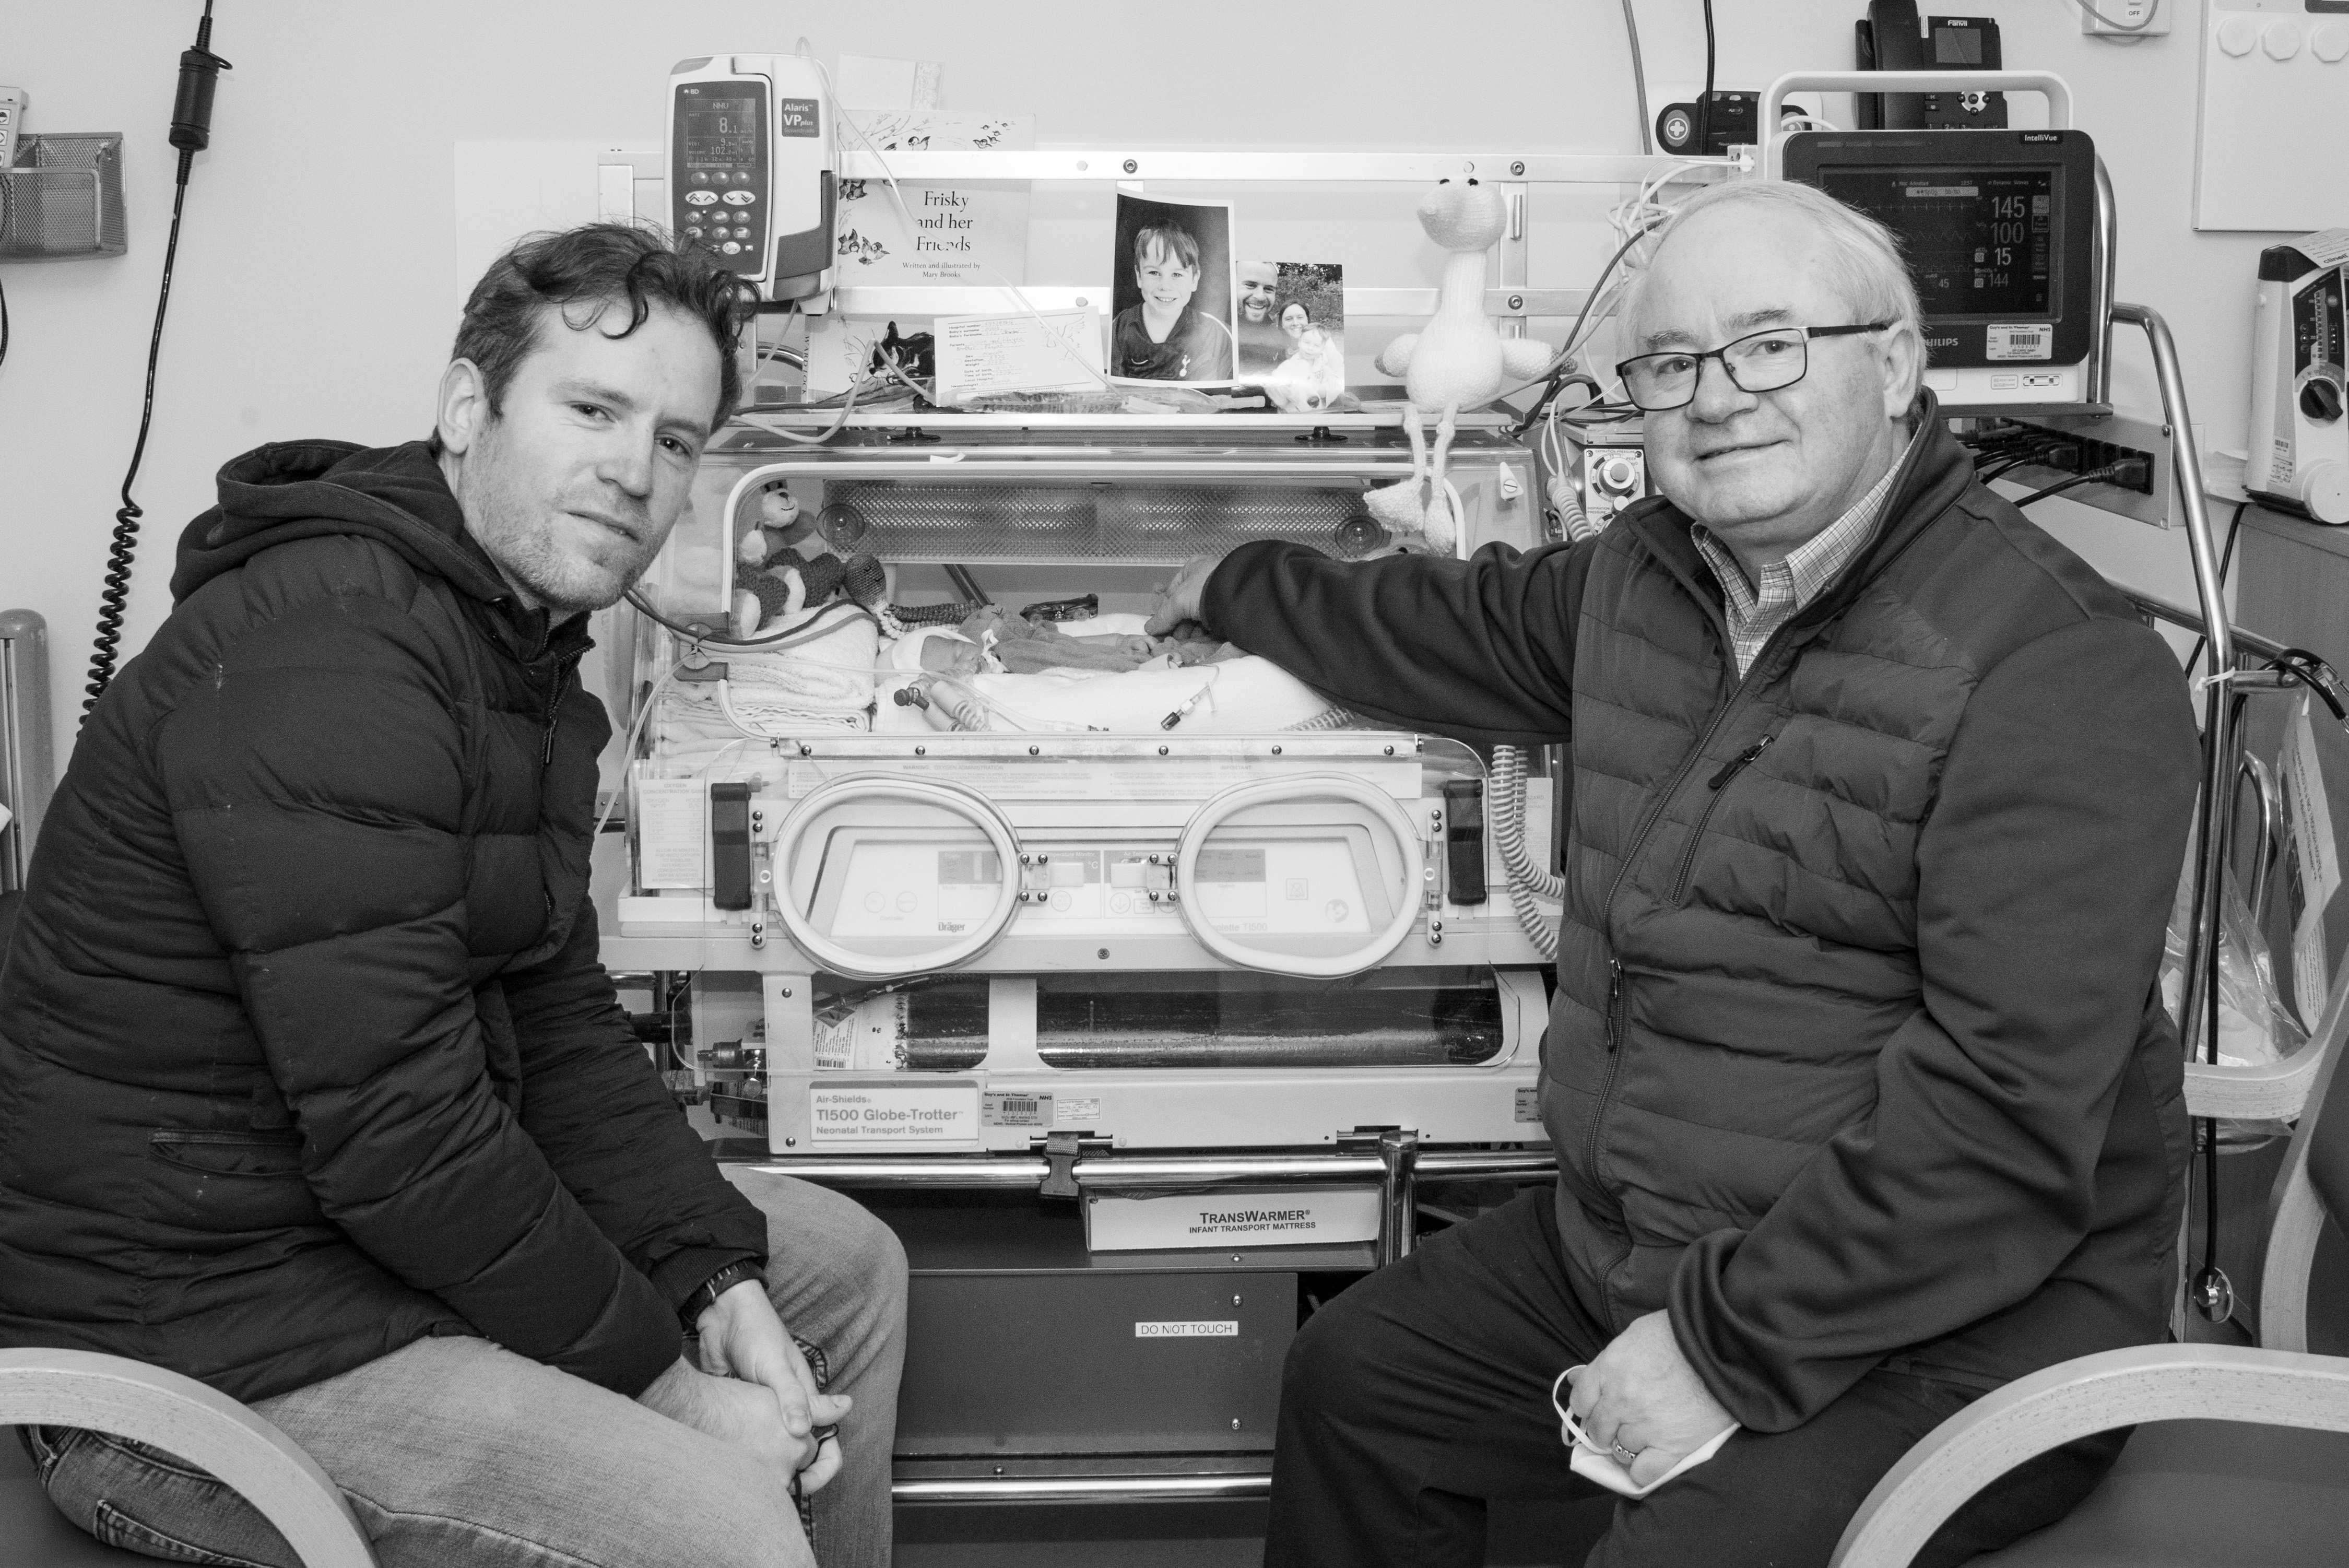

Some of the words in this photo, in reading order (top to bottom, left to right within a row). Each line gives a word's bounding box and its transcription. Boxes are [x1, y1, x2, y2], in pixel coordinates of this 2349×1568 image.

[924, 191, 969, 213] Frisky
[1991, 196, 2025, 218] 145
[917, 213, 943, 229] and
[949, 213, 973, 229] her
[1990, 222, 2024, 244] 100
[1994, 247, 2011, 265] 15
[973, 262, 981, 271] by
[923, 272, 938, 280] Mary
[1988, 273, 2009, 288] 144
[1938, 279, 1949, 288] 45
[1926, 338, 1958, 347] HILIPS
[938, 921, 965, 933] Dräger
[1211, 923, 1240, 932] solette
[1242, 922, 1268, 932] TI500
[816, 1109, 859, 1121] TI500
[861, 1126, 906, 1135] Transport
[908, 1125, 943, 1135] System
[1221, 1223, 1271, 1232] TRANSPORT
[1272, 1221, 1316, 1230] MATTRESS
[1141, 1325, 1159, 1335] DO
[1190, 1324, 1232, 1334] TOUCH
